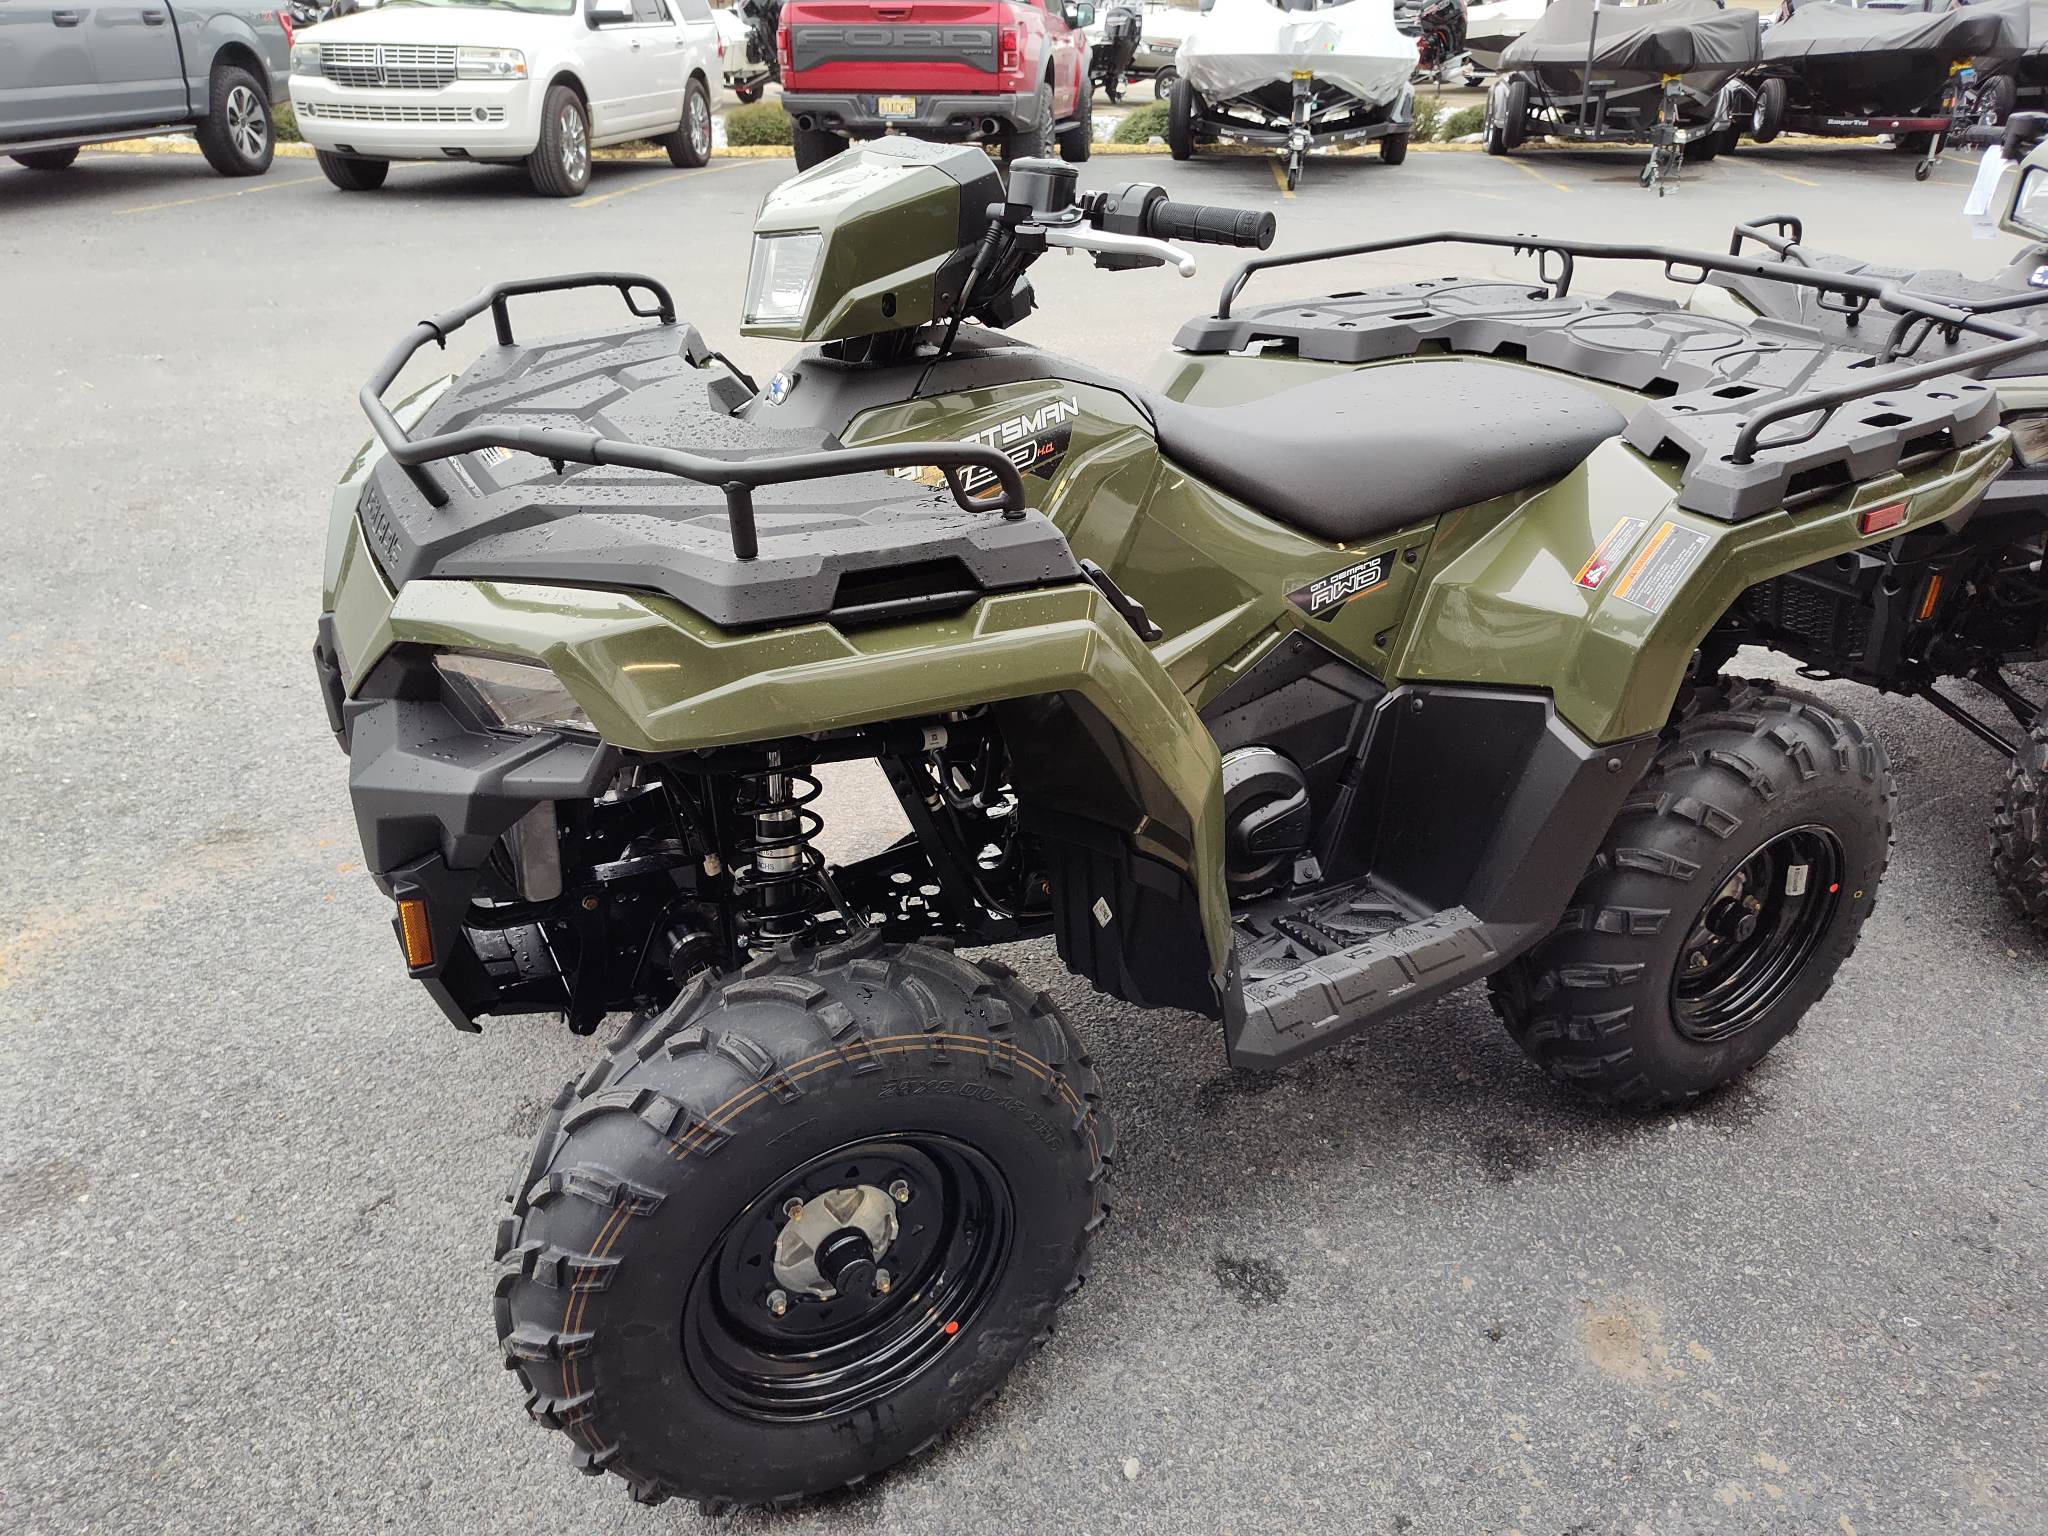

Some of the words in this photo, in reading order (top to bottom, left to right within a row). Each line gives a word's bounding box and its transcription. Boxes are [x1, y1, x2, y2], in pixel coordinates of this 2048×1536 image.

[797, 29, 993, 47] FORD
[1311, 580, 1327, 592] ON
[1330, 558, 1381, 583] DEMAND
[1311, 566, 1381, 611] AWD
